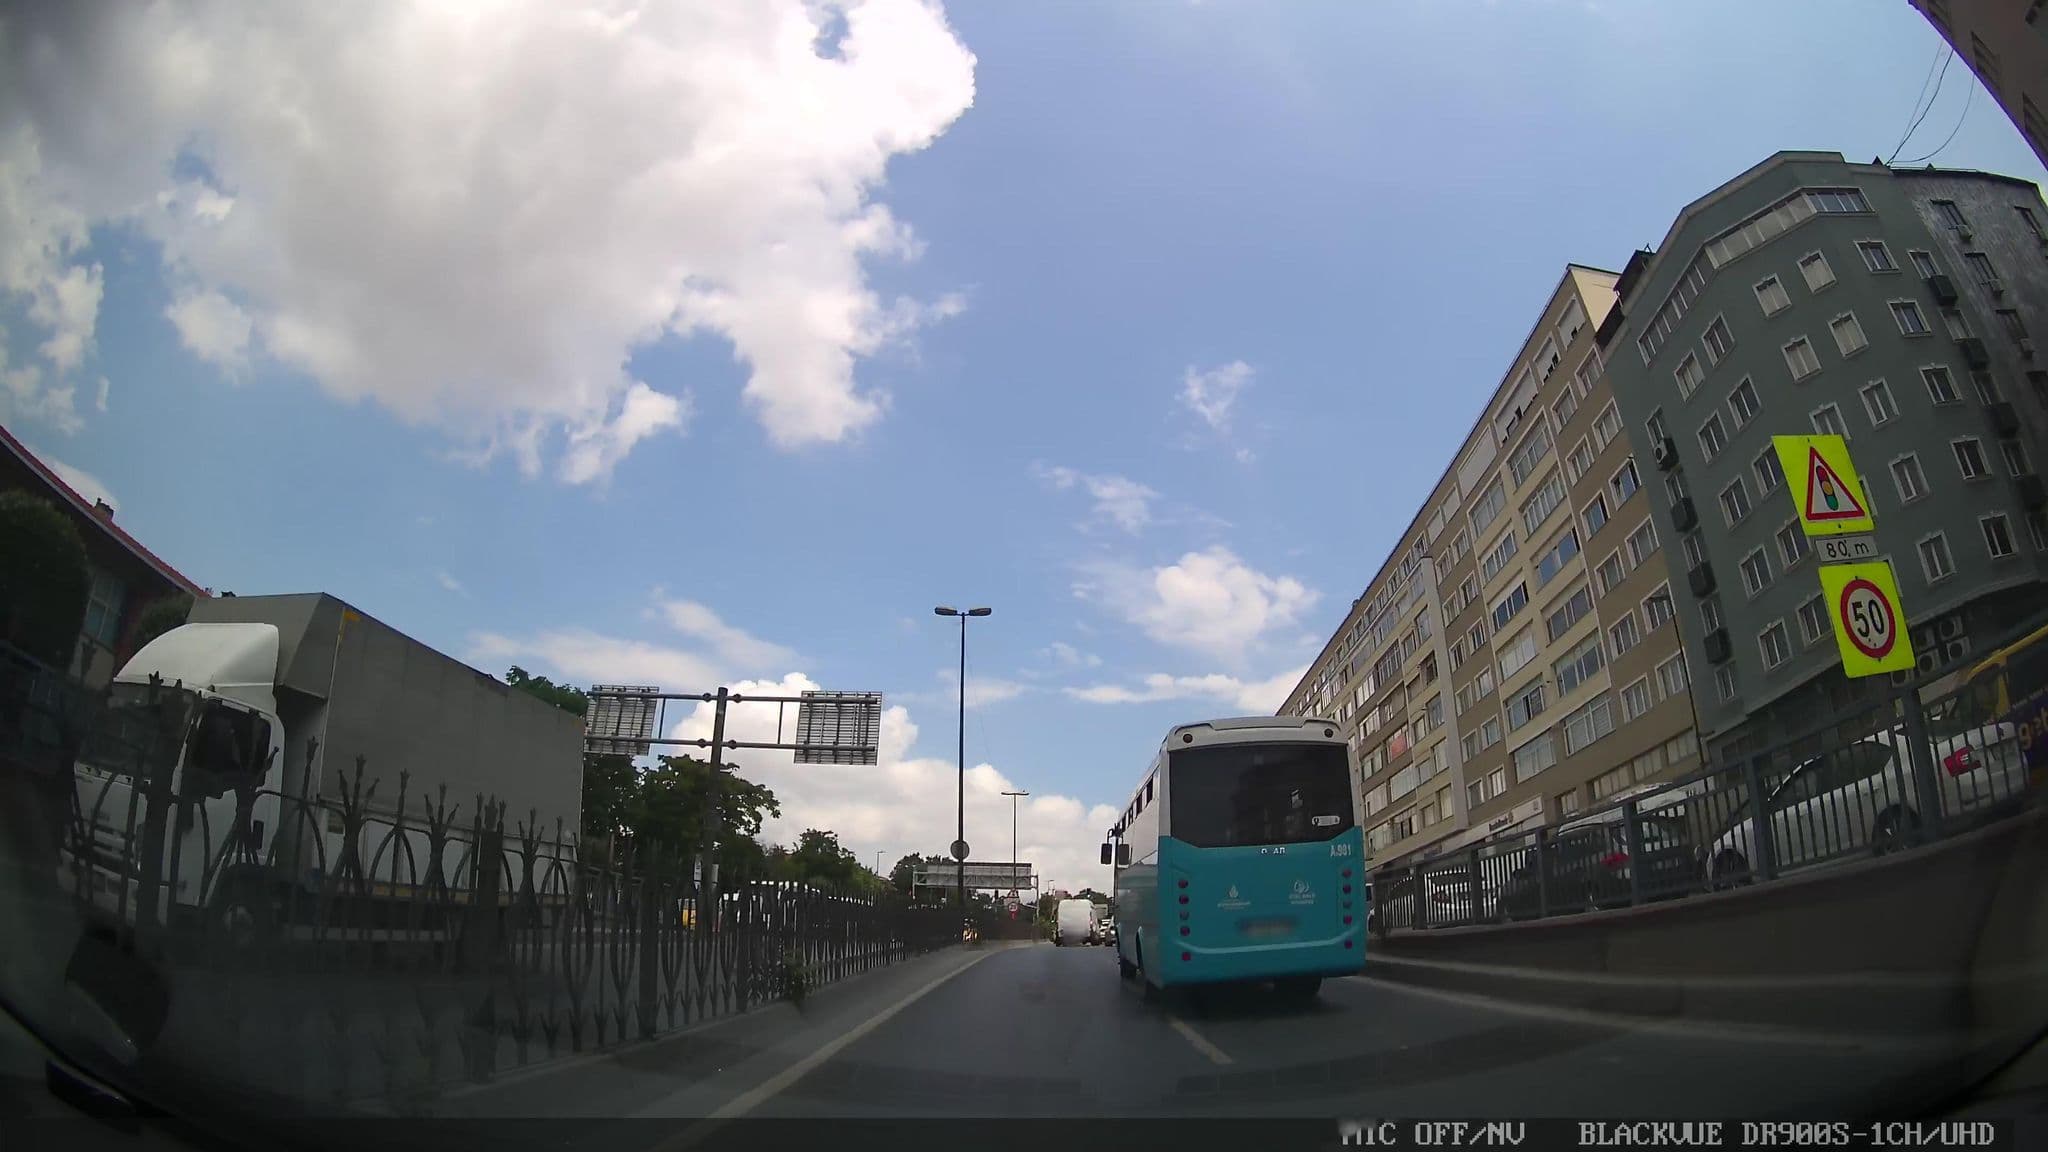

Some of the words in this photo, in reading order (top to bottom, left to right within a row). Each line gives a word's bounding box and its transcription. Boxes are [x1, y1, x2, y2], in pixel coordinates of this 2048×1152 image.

[1826, 541, 1848, 558] 80
[1855, 543, 1869, 555] m
[1851, 599, 1885, 638] 50
